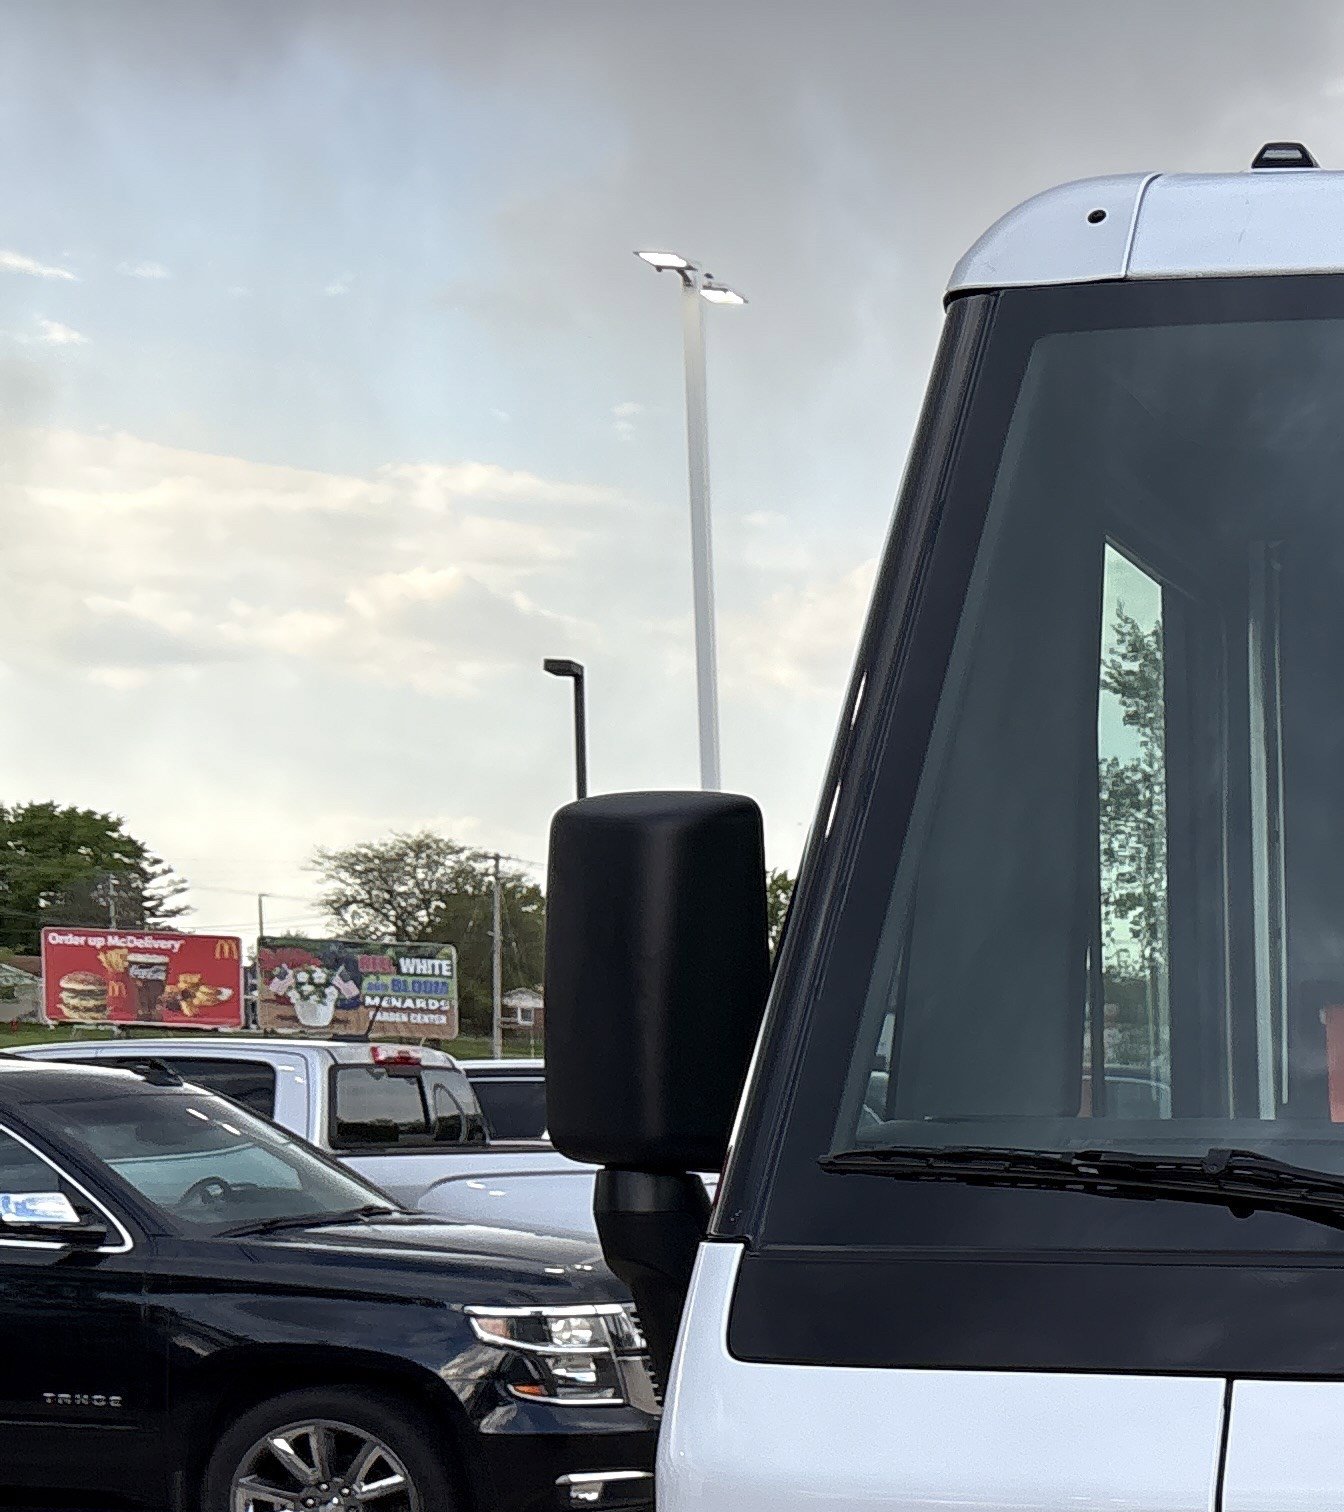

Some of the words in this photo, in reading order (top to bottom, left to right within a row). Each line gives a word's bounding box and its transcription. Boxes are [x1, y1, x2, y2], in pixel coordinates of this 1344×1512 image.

[49, 933, 86, 945] Order
[88, 936, 105, 948] up
[400, 957, 452, 976] WHITE
[365, 996, 450, 1010] MENARDS
[42, 1392, 122, 1407] TAHOE
